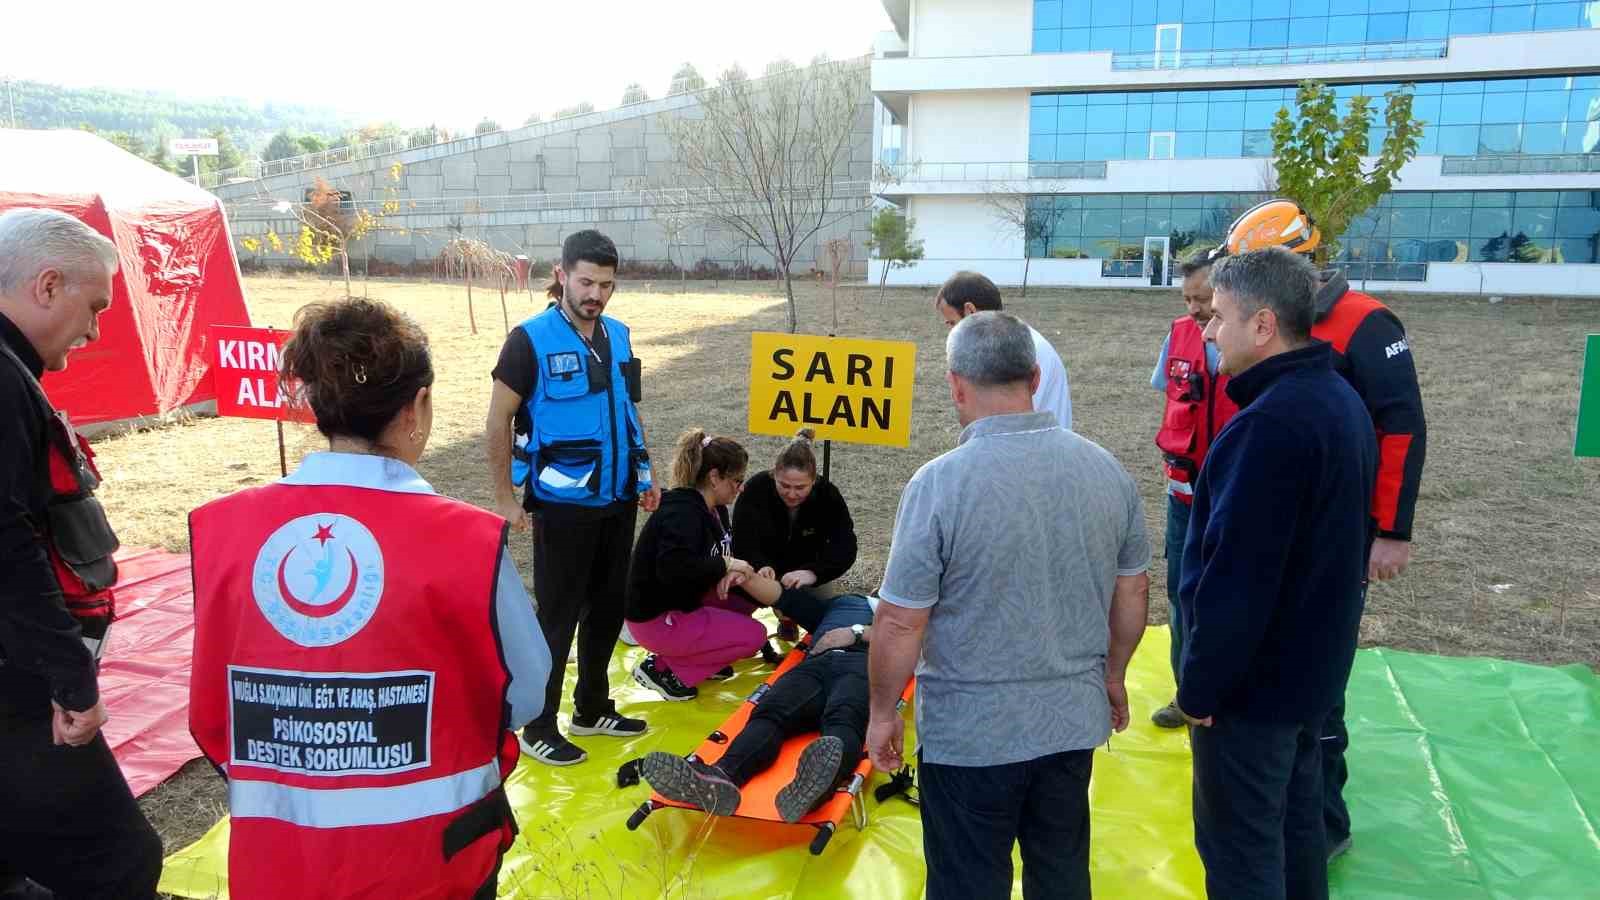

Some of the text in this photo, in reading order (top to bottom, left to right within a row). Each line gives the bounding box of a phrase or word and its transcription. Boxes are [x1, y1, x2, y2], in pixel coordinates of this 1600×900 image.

[771, 348, 894, 388] SARI
[768, 390, 891, 430] ALAN
[336, 687, 350, 708] VE
[350, 687, 377, 714] ARAŞ.
[378, 680, 428, 708] HASTANESİ
[273, 715, 378, 745] PSİKOSOSYAL
[247, 739, 413, 771] DESTEK SORUMLUSU
